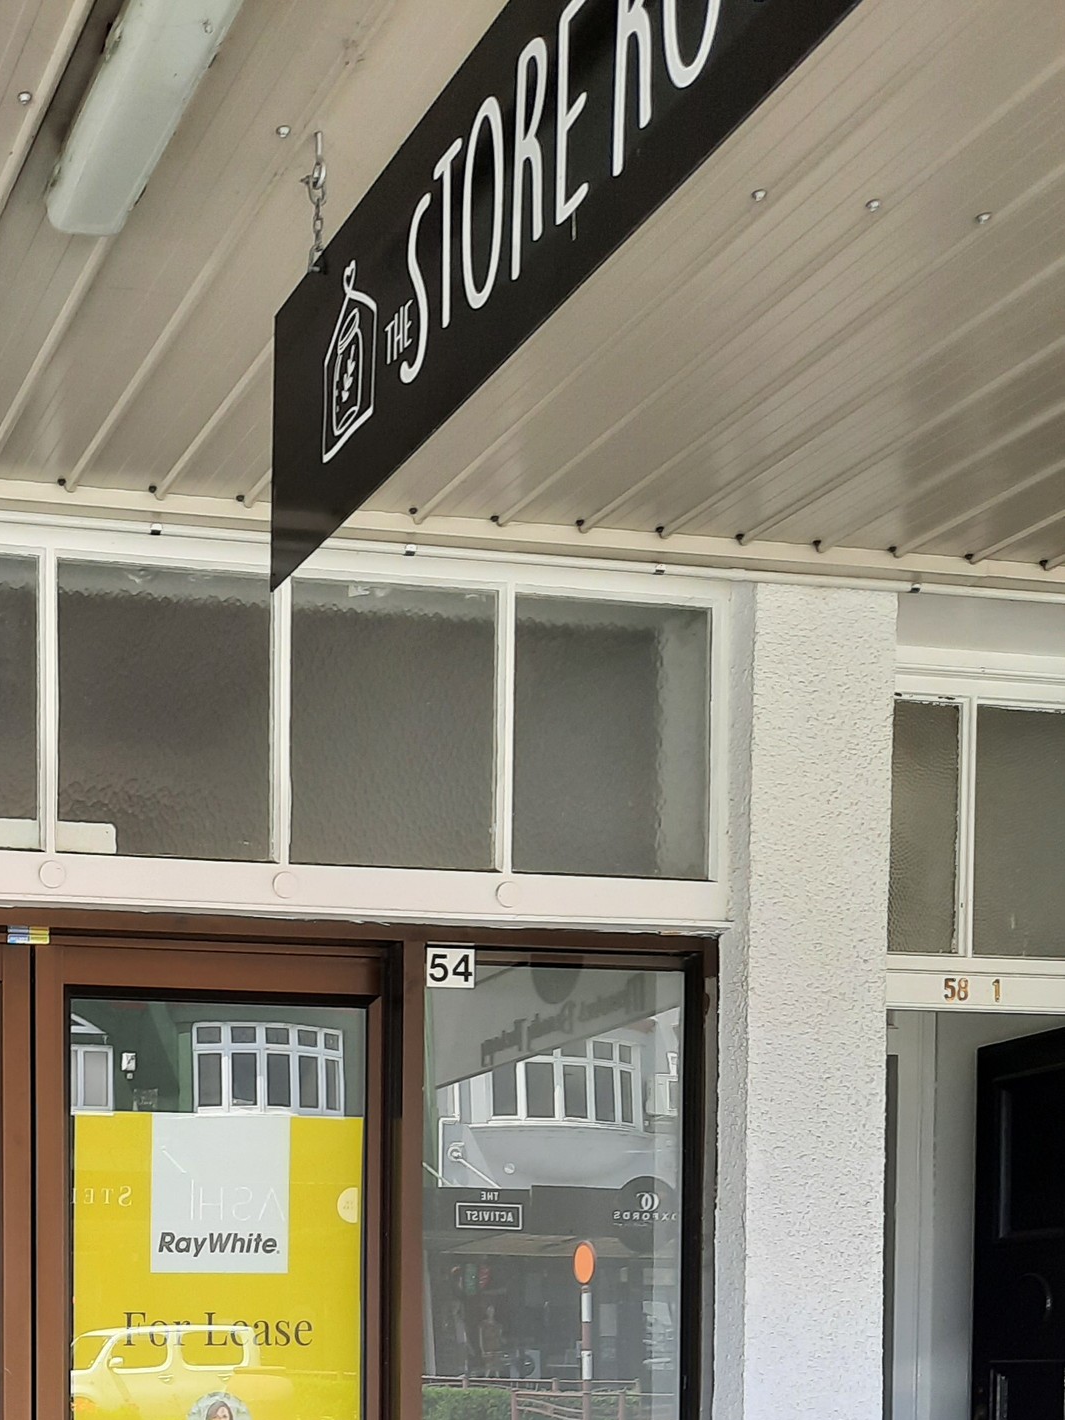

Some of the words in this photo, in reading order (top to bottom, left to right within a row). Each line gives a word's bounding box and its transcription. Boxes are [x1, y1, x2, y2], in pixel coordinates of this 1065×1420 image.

[385, 300, 413, 365] THE
[400, 0, 589, 384] STORE
[429, 953, 473, 983] 54
[944, 978, 969, 1002] 58
[992, 978, 1001, 1003] 1
[123, 1311, 194, 1348] For
[204, 1311, 314, 1348] Lease
